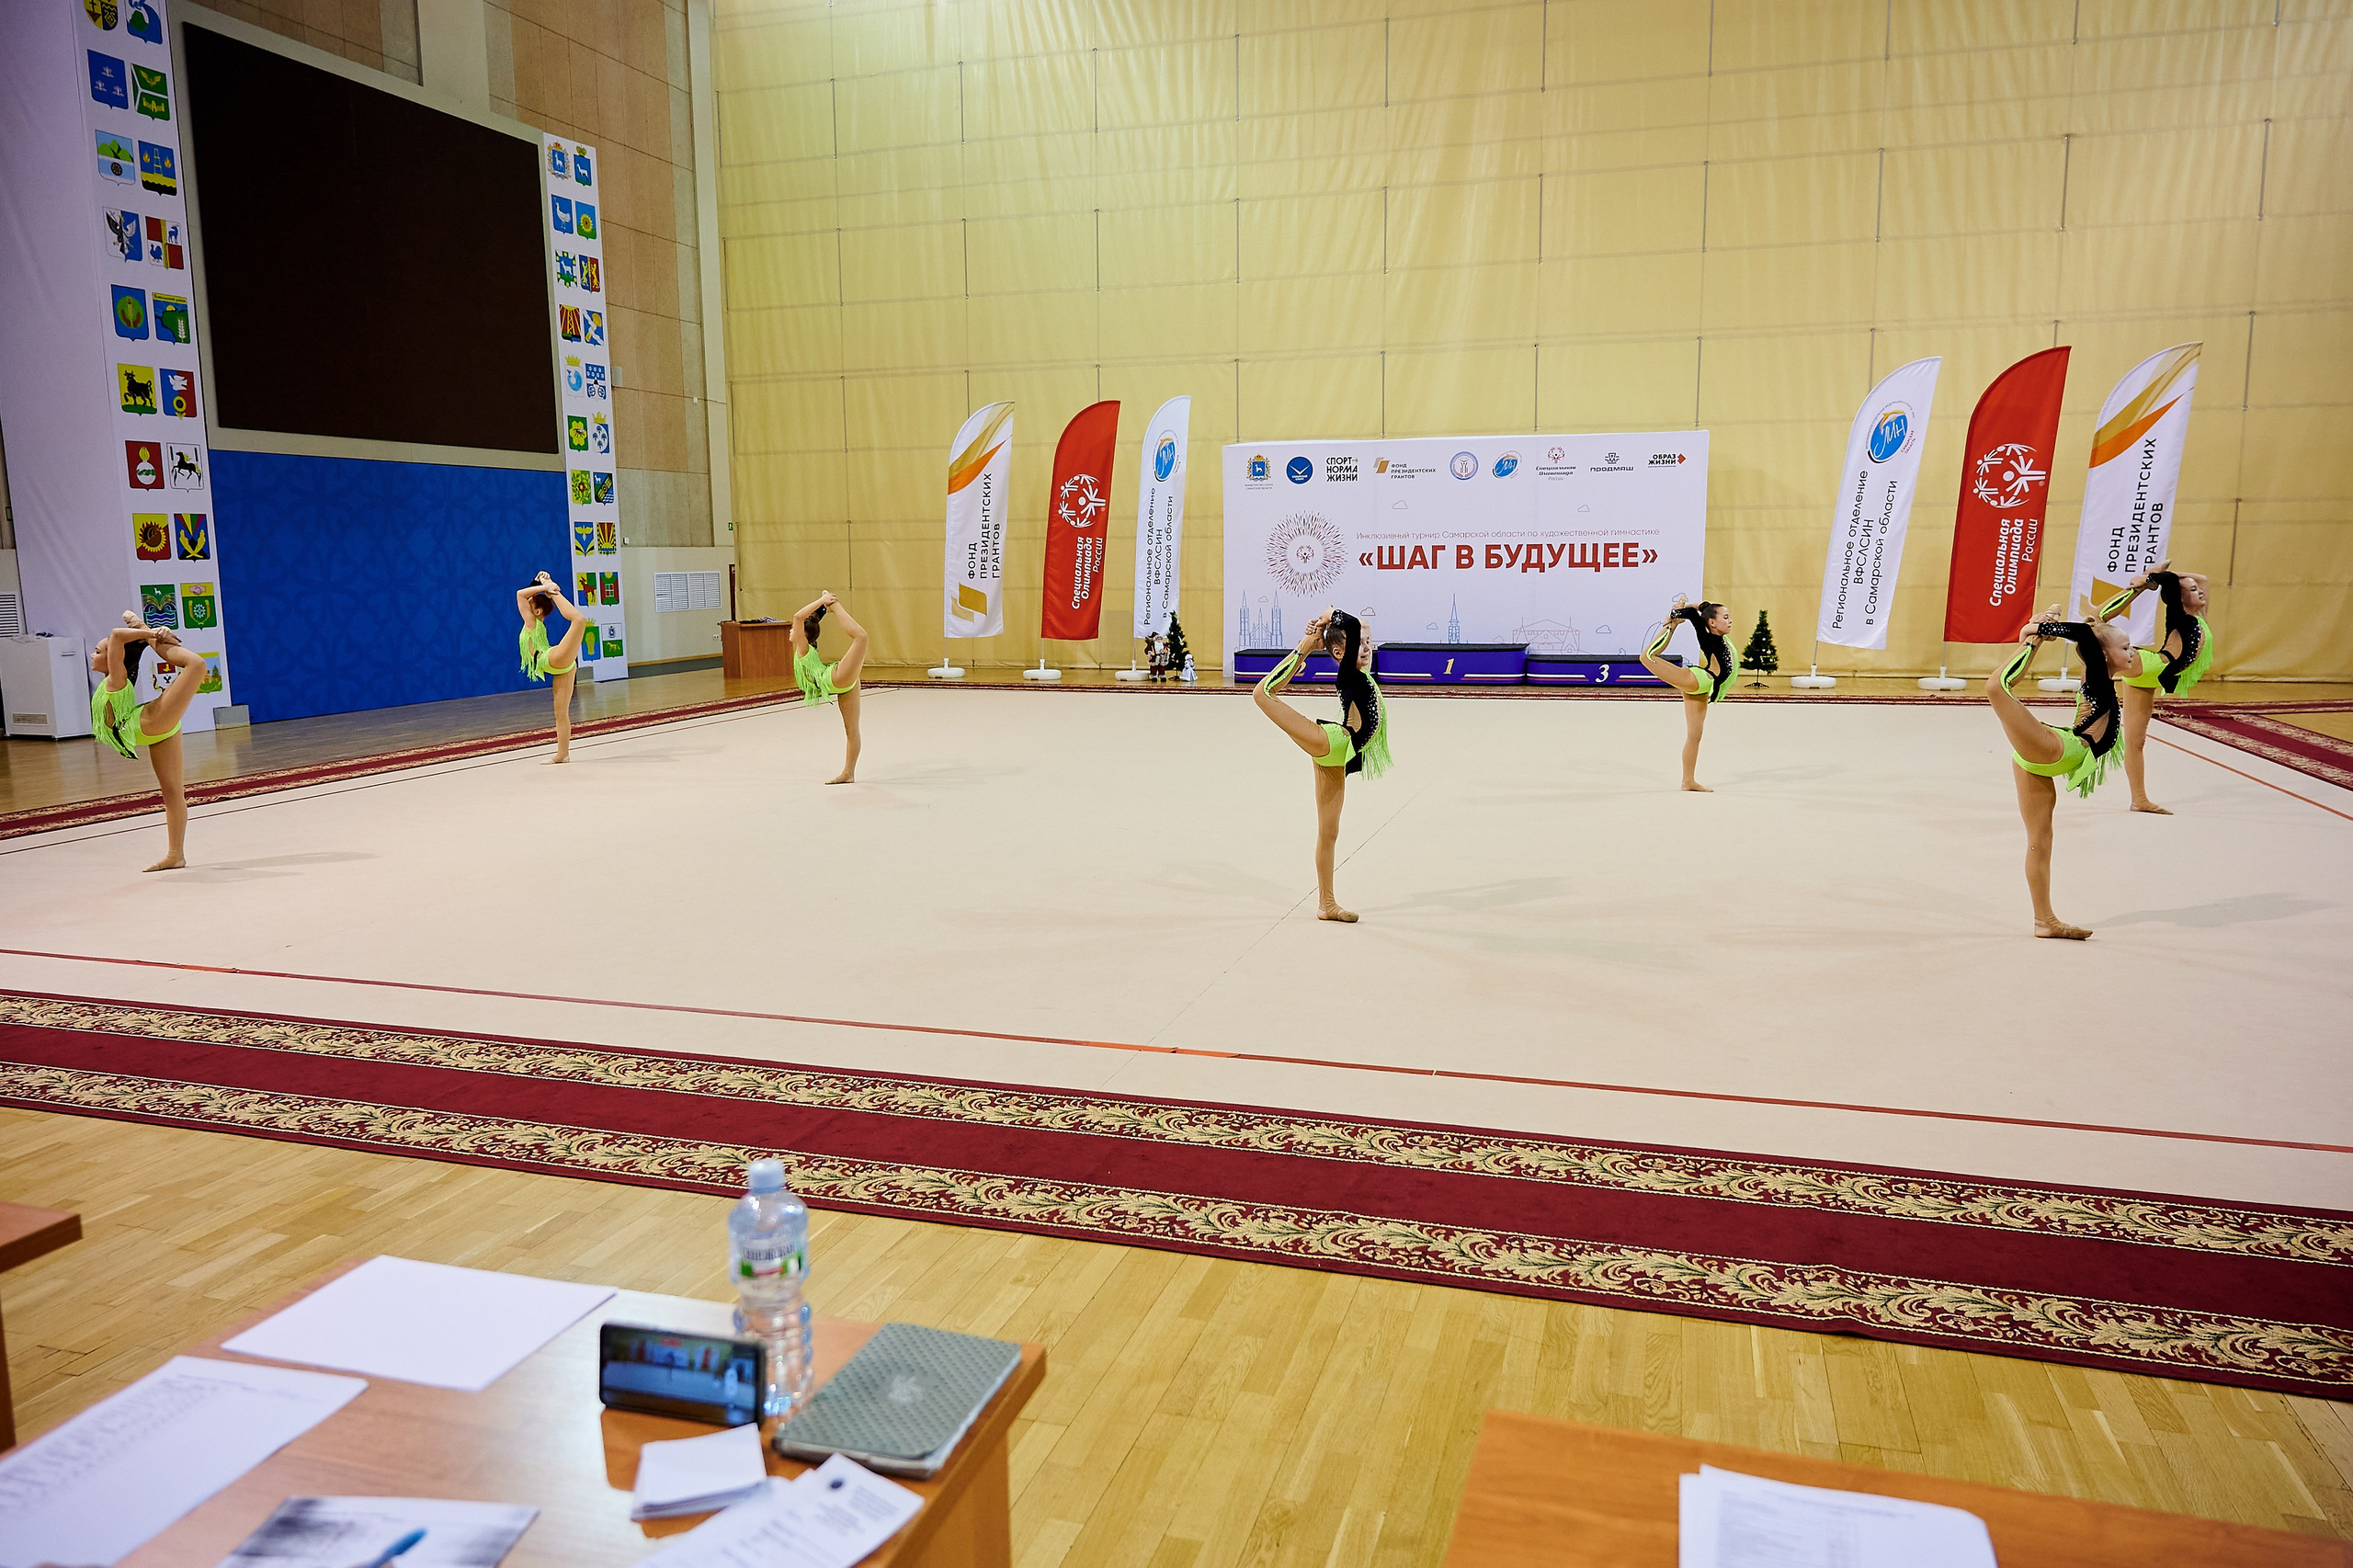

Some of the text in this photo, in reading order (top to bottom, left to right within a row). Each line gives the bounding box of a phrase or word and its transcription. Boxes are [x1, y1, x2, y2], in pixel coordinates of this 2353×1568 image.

[1326, 457, 1352, 465] СПОРТ
[1326, 465, 1358, 473] НОРМА
[1326, 473, 1358, 483] ЖИЗНИ
[980, 473, 992, 579] ПРЕЗИДЕНТСКИХ
[1165, 495, 1173, 541] области
[2125, 438, 2156, 573] ПРЕЗИДЕНТСКИХ
[968, 542, 977, 579] ФОНД
[992, 523, 1000, 579] ГРАНТОВ
[1093, 537, 1103, 573] России
[1143, 487, 1155, 625] Региональное отделение
[1154, 528, 1163, 585] ВФСЛСИН
[1358, 542, 1658, 573] «ШАГ В БУДУЩЕЕ»
[1411, 532, 1440, 540] турнир
[1442, 530, 1489, 540] Самарской
[1491, 530, 1526, 539] области
[1540, 529, 1608, 538] художественной
[1832, 471, 1868, 629] Региональное отделение
[1853, 519, 1874, 585] ВФСЛСИН
[1864, 539, 1884, 614] Самарской
[1879, 481, 1897, 534] области
[1989, 518, 2010, 607] Специальная
[2004, 518, 2024, 595] Олимпиада
[2021, 518, 2038, 562] России
[2107, 527, 2125, 573] ФОНД
[1071, 536, 1085, 609] Специальная
[1081, 537, 1093, 599] Олимпиада
[1162, 544, 1172, 609] Самарской
[1443, 657, 1455, 675] 1
[1595, 664, 1609, 683] 3
